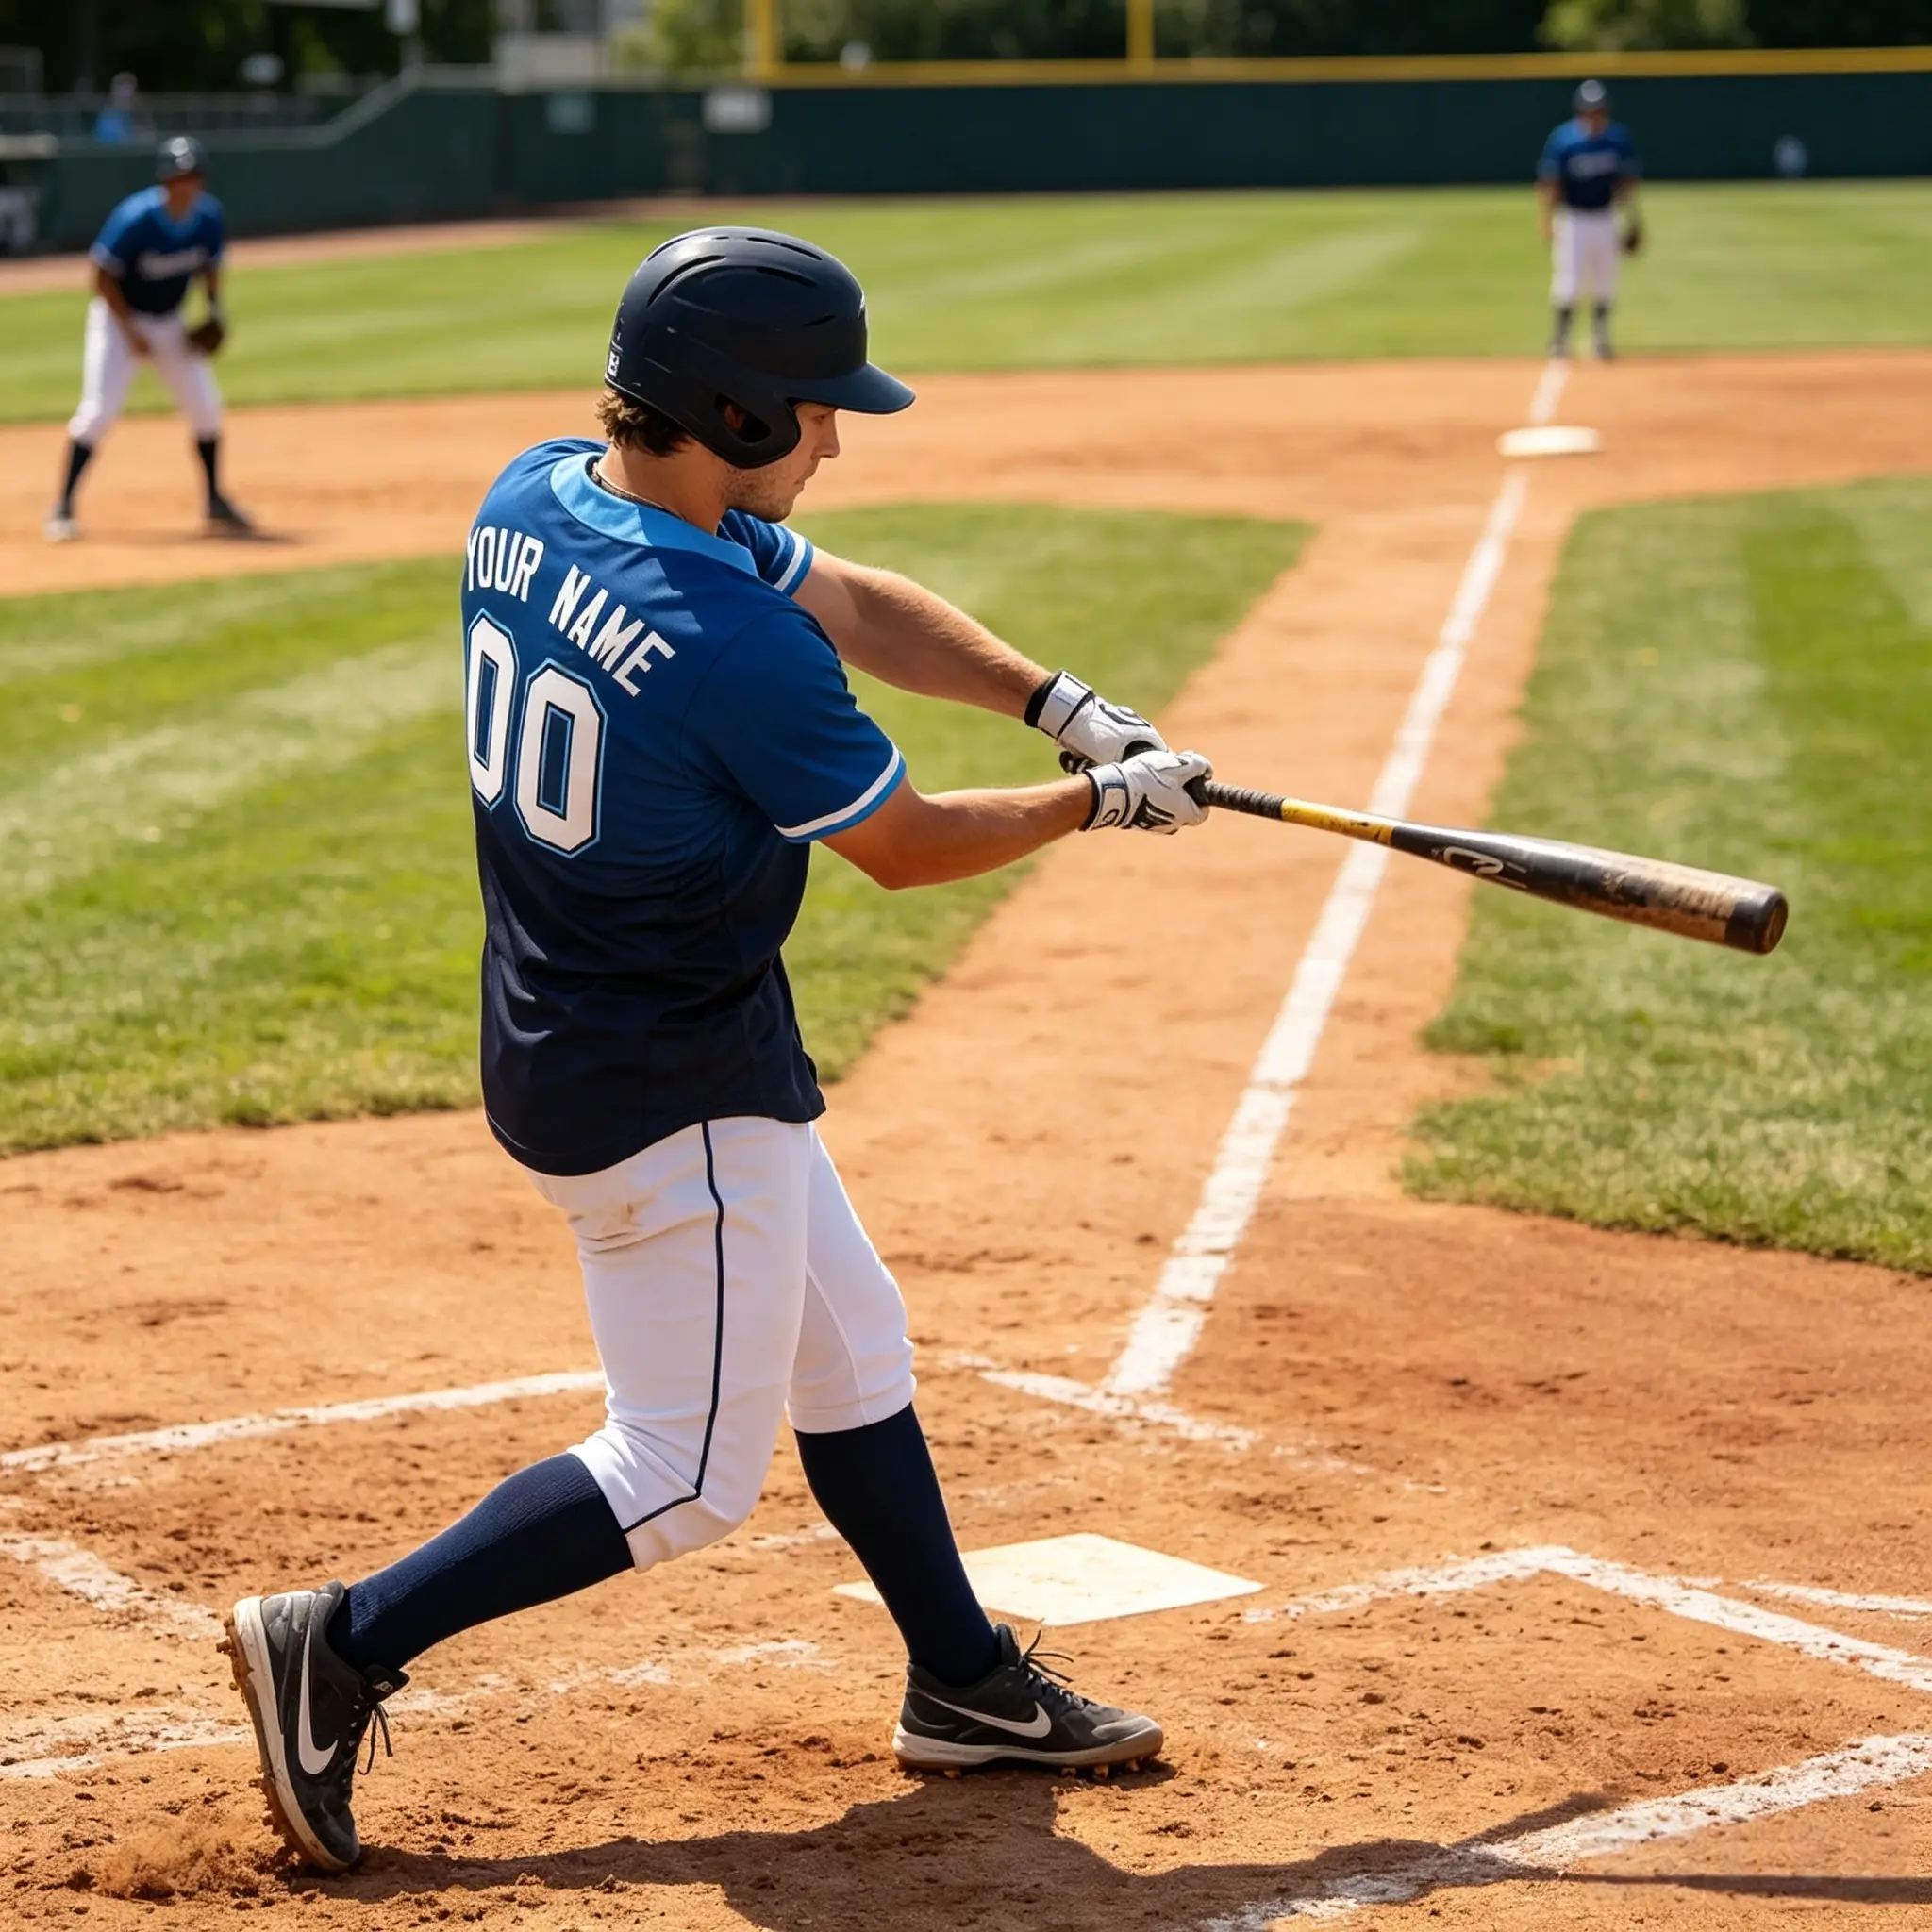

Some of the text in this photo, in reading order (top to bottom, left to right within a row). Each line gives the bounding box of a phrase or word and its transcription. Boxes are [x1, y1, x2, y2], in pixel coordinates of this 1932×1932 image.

[467, 525, 676, 697] YOUR NAME
[466, 608, 608, 858] 00
